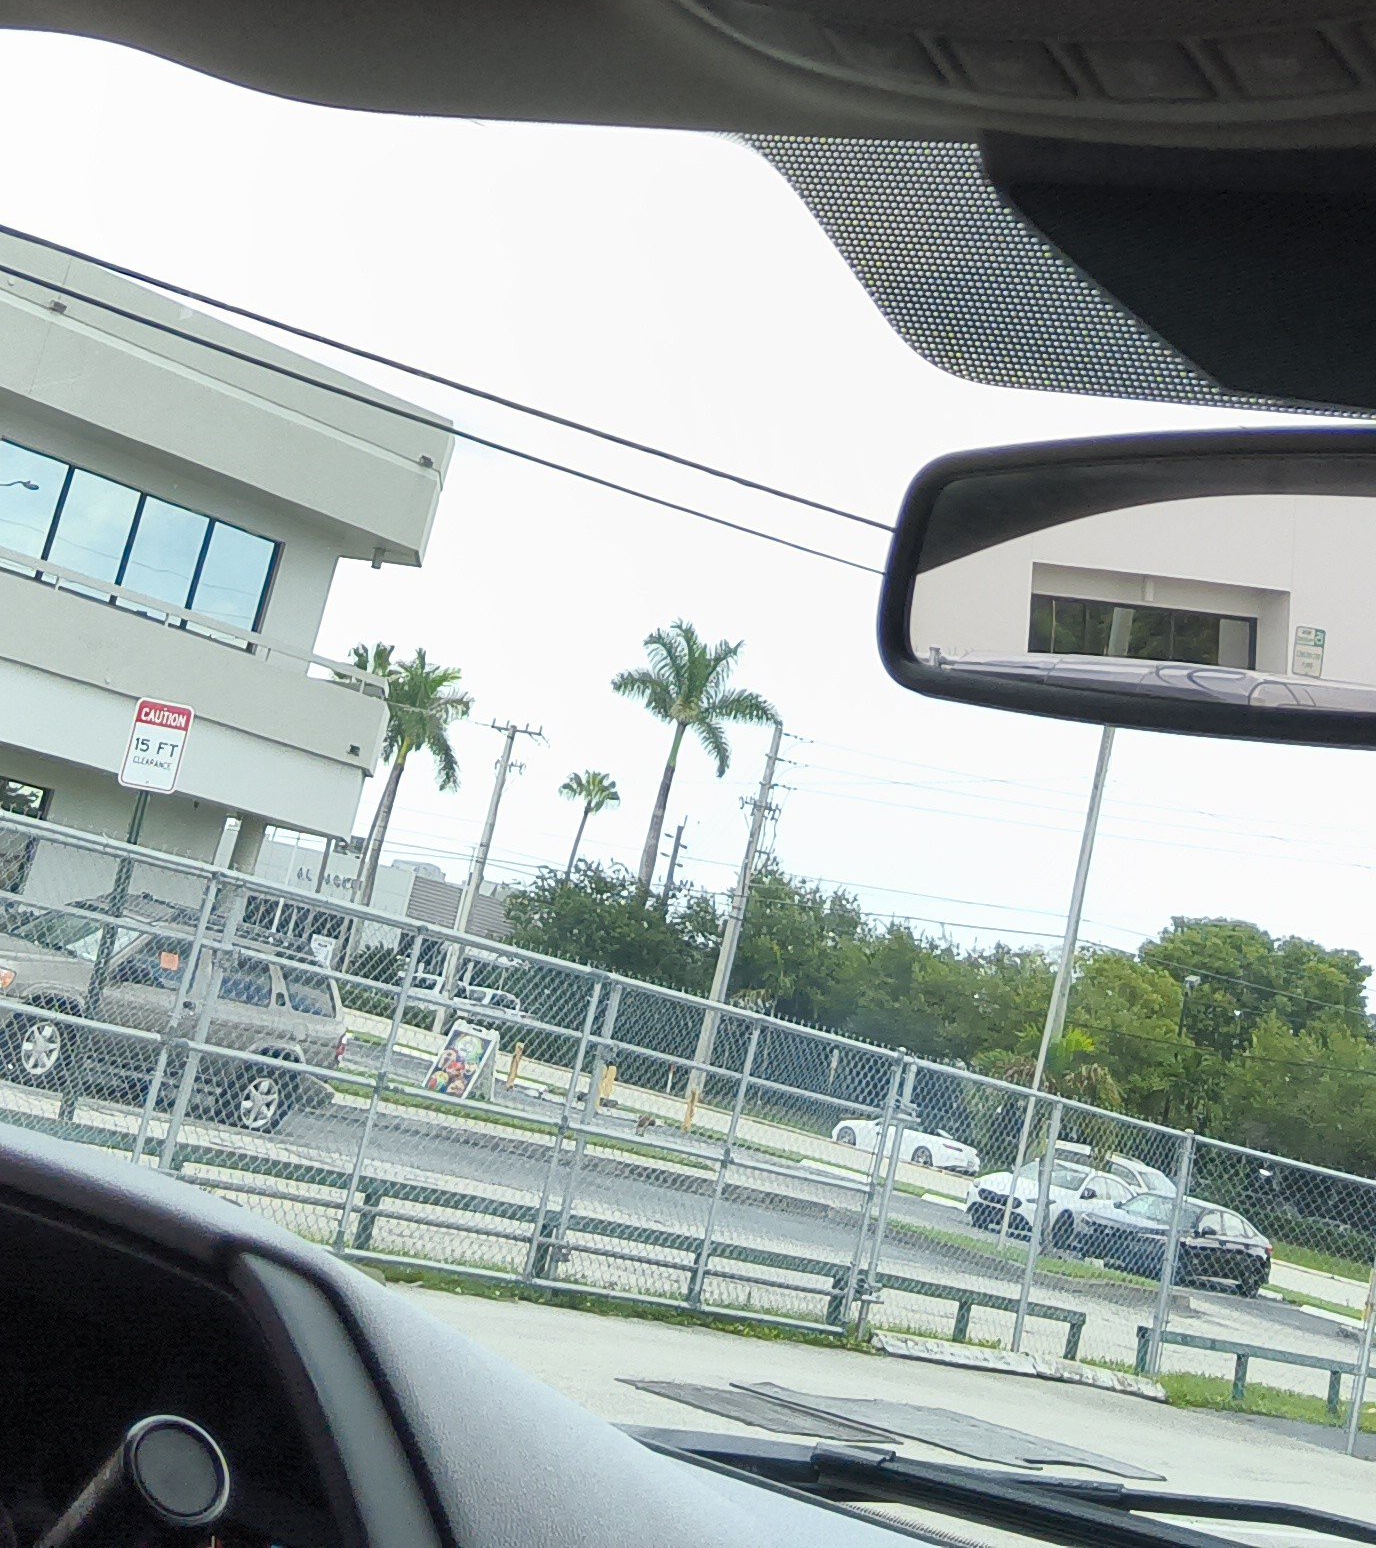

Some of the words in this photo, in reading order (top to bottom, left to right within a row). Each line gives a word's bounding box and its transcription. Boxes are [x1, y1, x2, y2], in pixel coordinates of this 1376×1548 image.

[141, 707, 187, 728] CAUTION
[135, 737, 151, 753] 15
[156, 741, 179, 758] FT
[132, 755, 172, 770] CLEARANCE
